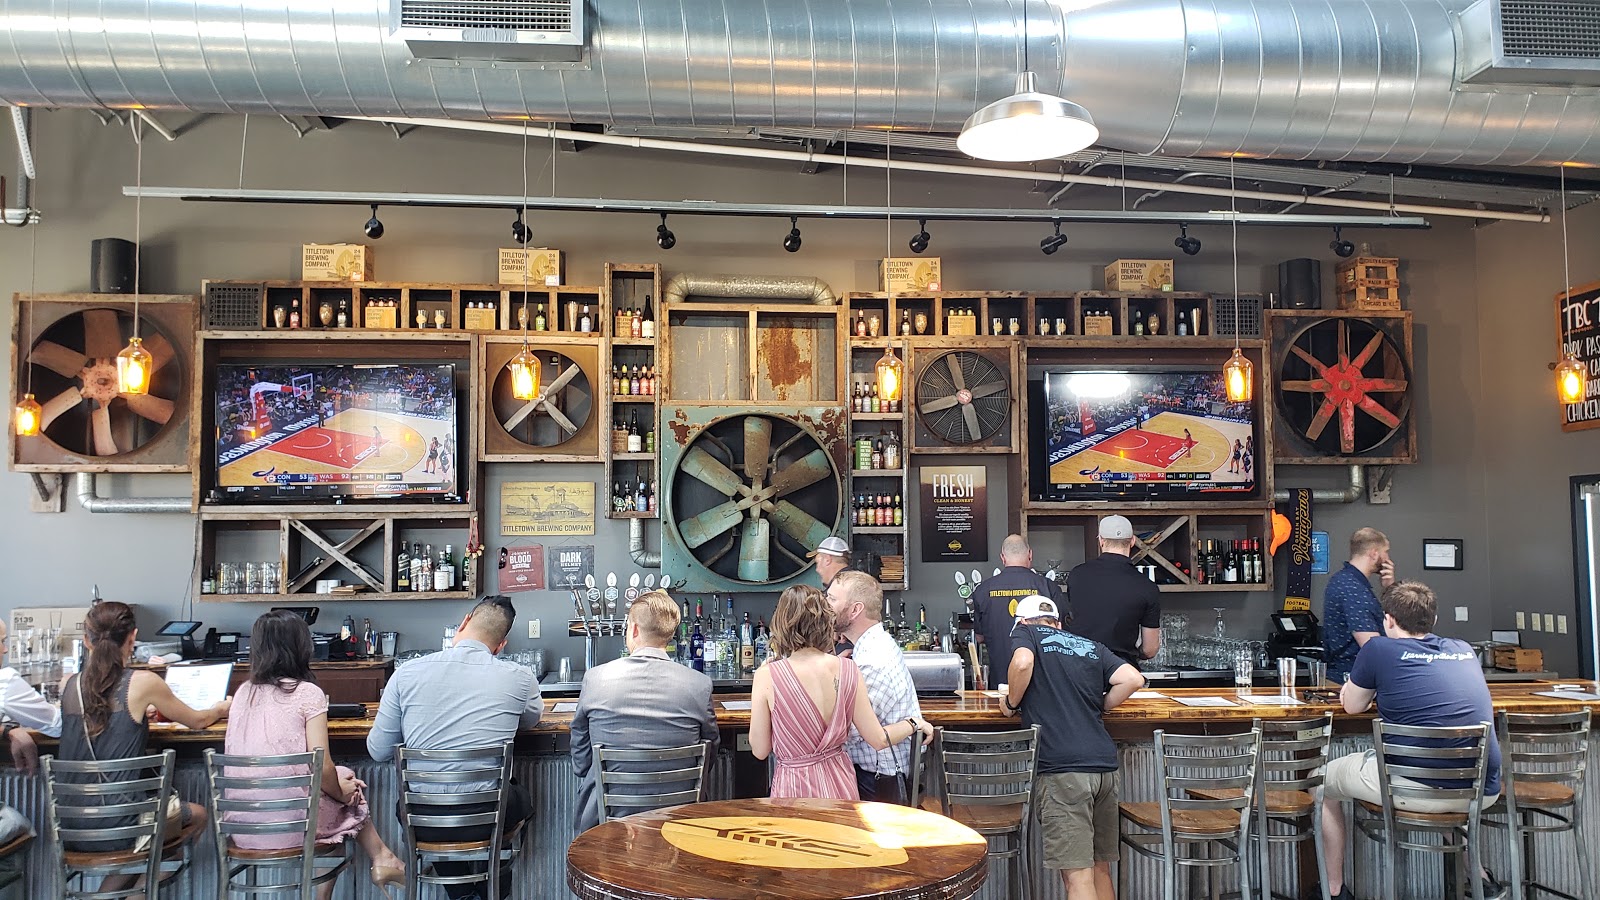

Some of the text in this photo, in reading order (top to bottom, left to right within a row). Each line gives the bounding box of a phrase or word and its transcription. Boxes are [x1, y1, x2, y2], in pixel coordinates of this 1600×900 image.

[1562, 299, 1592, 330] TBC
[932, 473, 974, 498] FRESH
[537, 524, 563, 532] BREWING
[564, 524, 593, 532] COMPANY
[1291, 488, 1312, 566] Voyageurs
[509, 554, 532, 564] BLOOD
[560, 552, 582, 563] DARK
[989, 590, 1013, 598] TITLETOWN
[1043, 645, 1074, 656] BREWING
[1400, 651, 1434, 663] Learning
